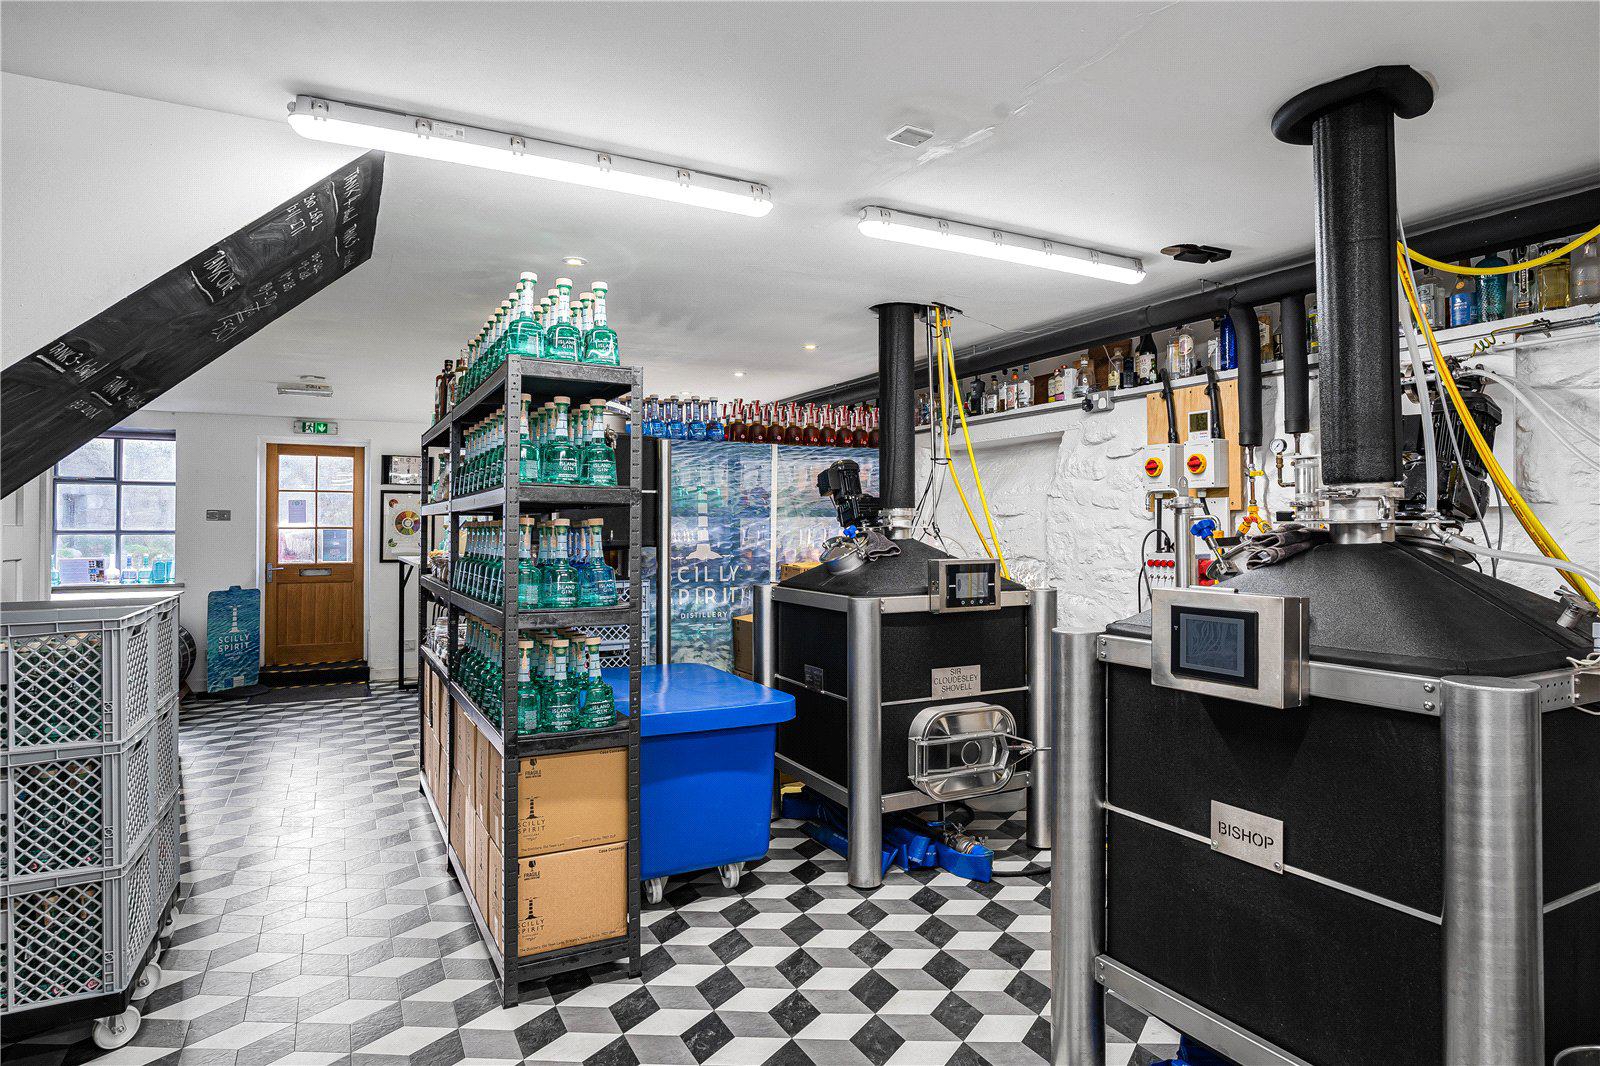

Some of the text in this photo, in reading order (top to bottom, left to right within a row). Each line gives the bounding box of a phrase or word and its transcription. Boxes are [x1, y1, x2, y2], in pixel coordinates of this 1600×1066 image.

[203, 249, 229, 283] TANK
[674, 565, 739, 583] CILLY
[680, 611, 728, 619] DISTILLERY
[218, 633, 250, 644] SCILLY
[218, 641, 249, 653] SPIRIT
[950, 668, 962, 676] SIR
[933, 674, 978, 686] CLOUDESLEY
[941, 683, 972, 693] SHOVELL
[592, 703, 610, 711] ISLAND
[1218, 820, 1274, 849] BISHOP
